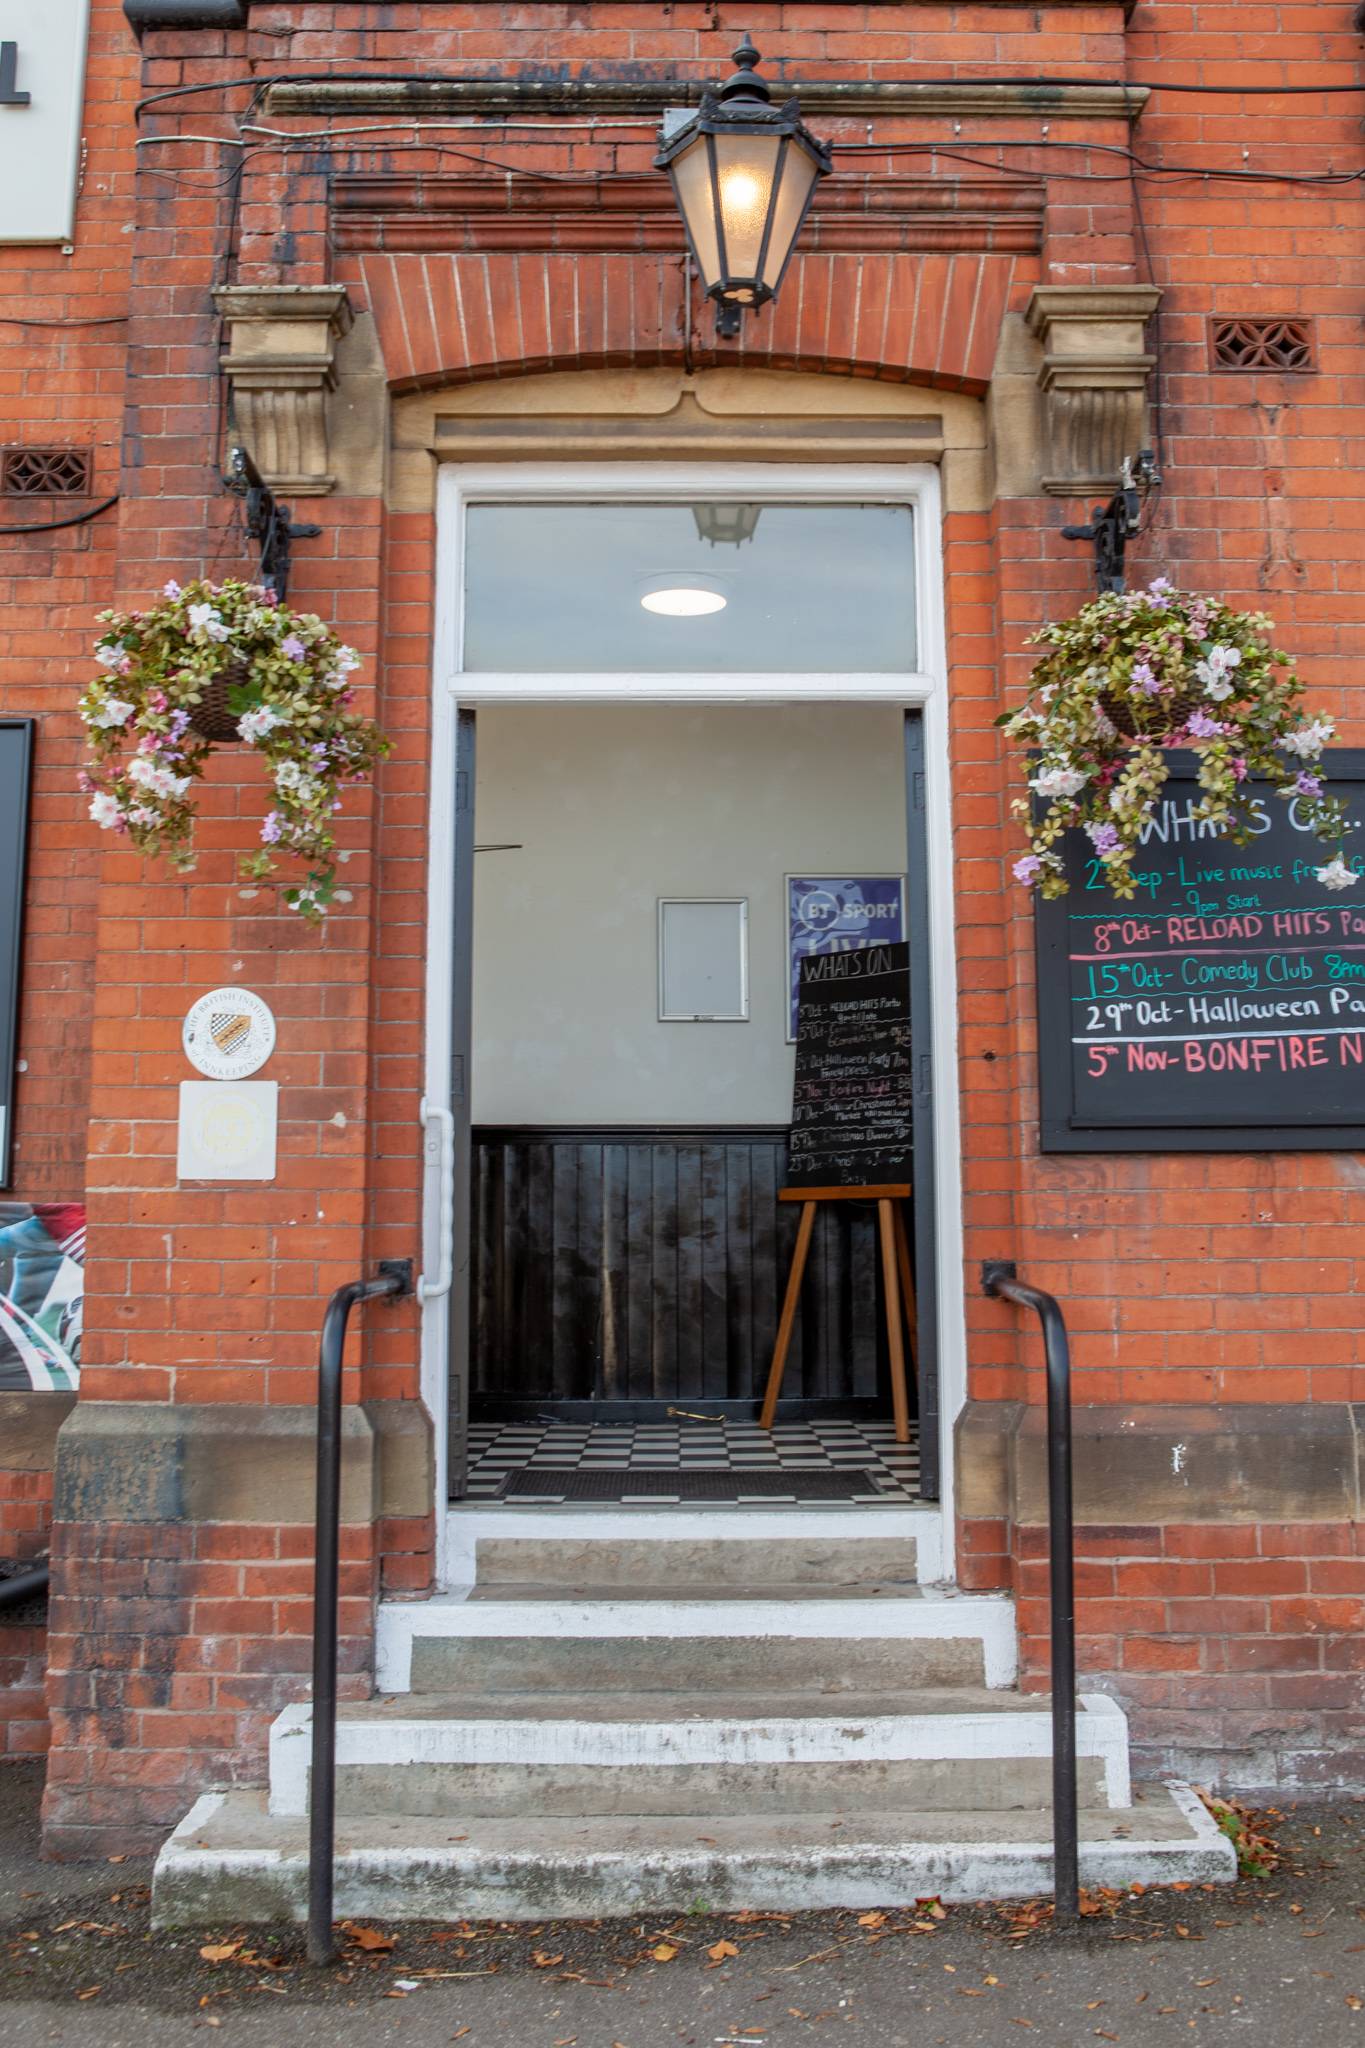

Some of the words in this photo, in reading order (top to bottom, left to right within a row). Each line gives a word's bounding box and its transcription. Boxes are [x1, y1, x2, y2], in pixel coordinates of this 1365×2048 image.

[1230, 865, 1283, 880] music
[808, 903, 831, 919] BT
[843, 903, 898, 919] SPORT
[1167, 916, 1263, 945] RELOAD
[1273, 911, 1331, 937] HITS
[866, 946, 892, 974] ON
[1181, 957, 1258, 988] Comedy
[1265, 955, 1313, 982] Club
[198, 992, 235, 1014] BRITISH
[239, 994, 271, 1036] INSTITUTE
[1188, 996, 1321, 1024] Halloween
[199, 1055, 262, 1076] INNKEEPING
[1184, 1036, 1329, 1073] BONFIRE
